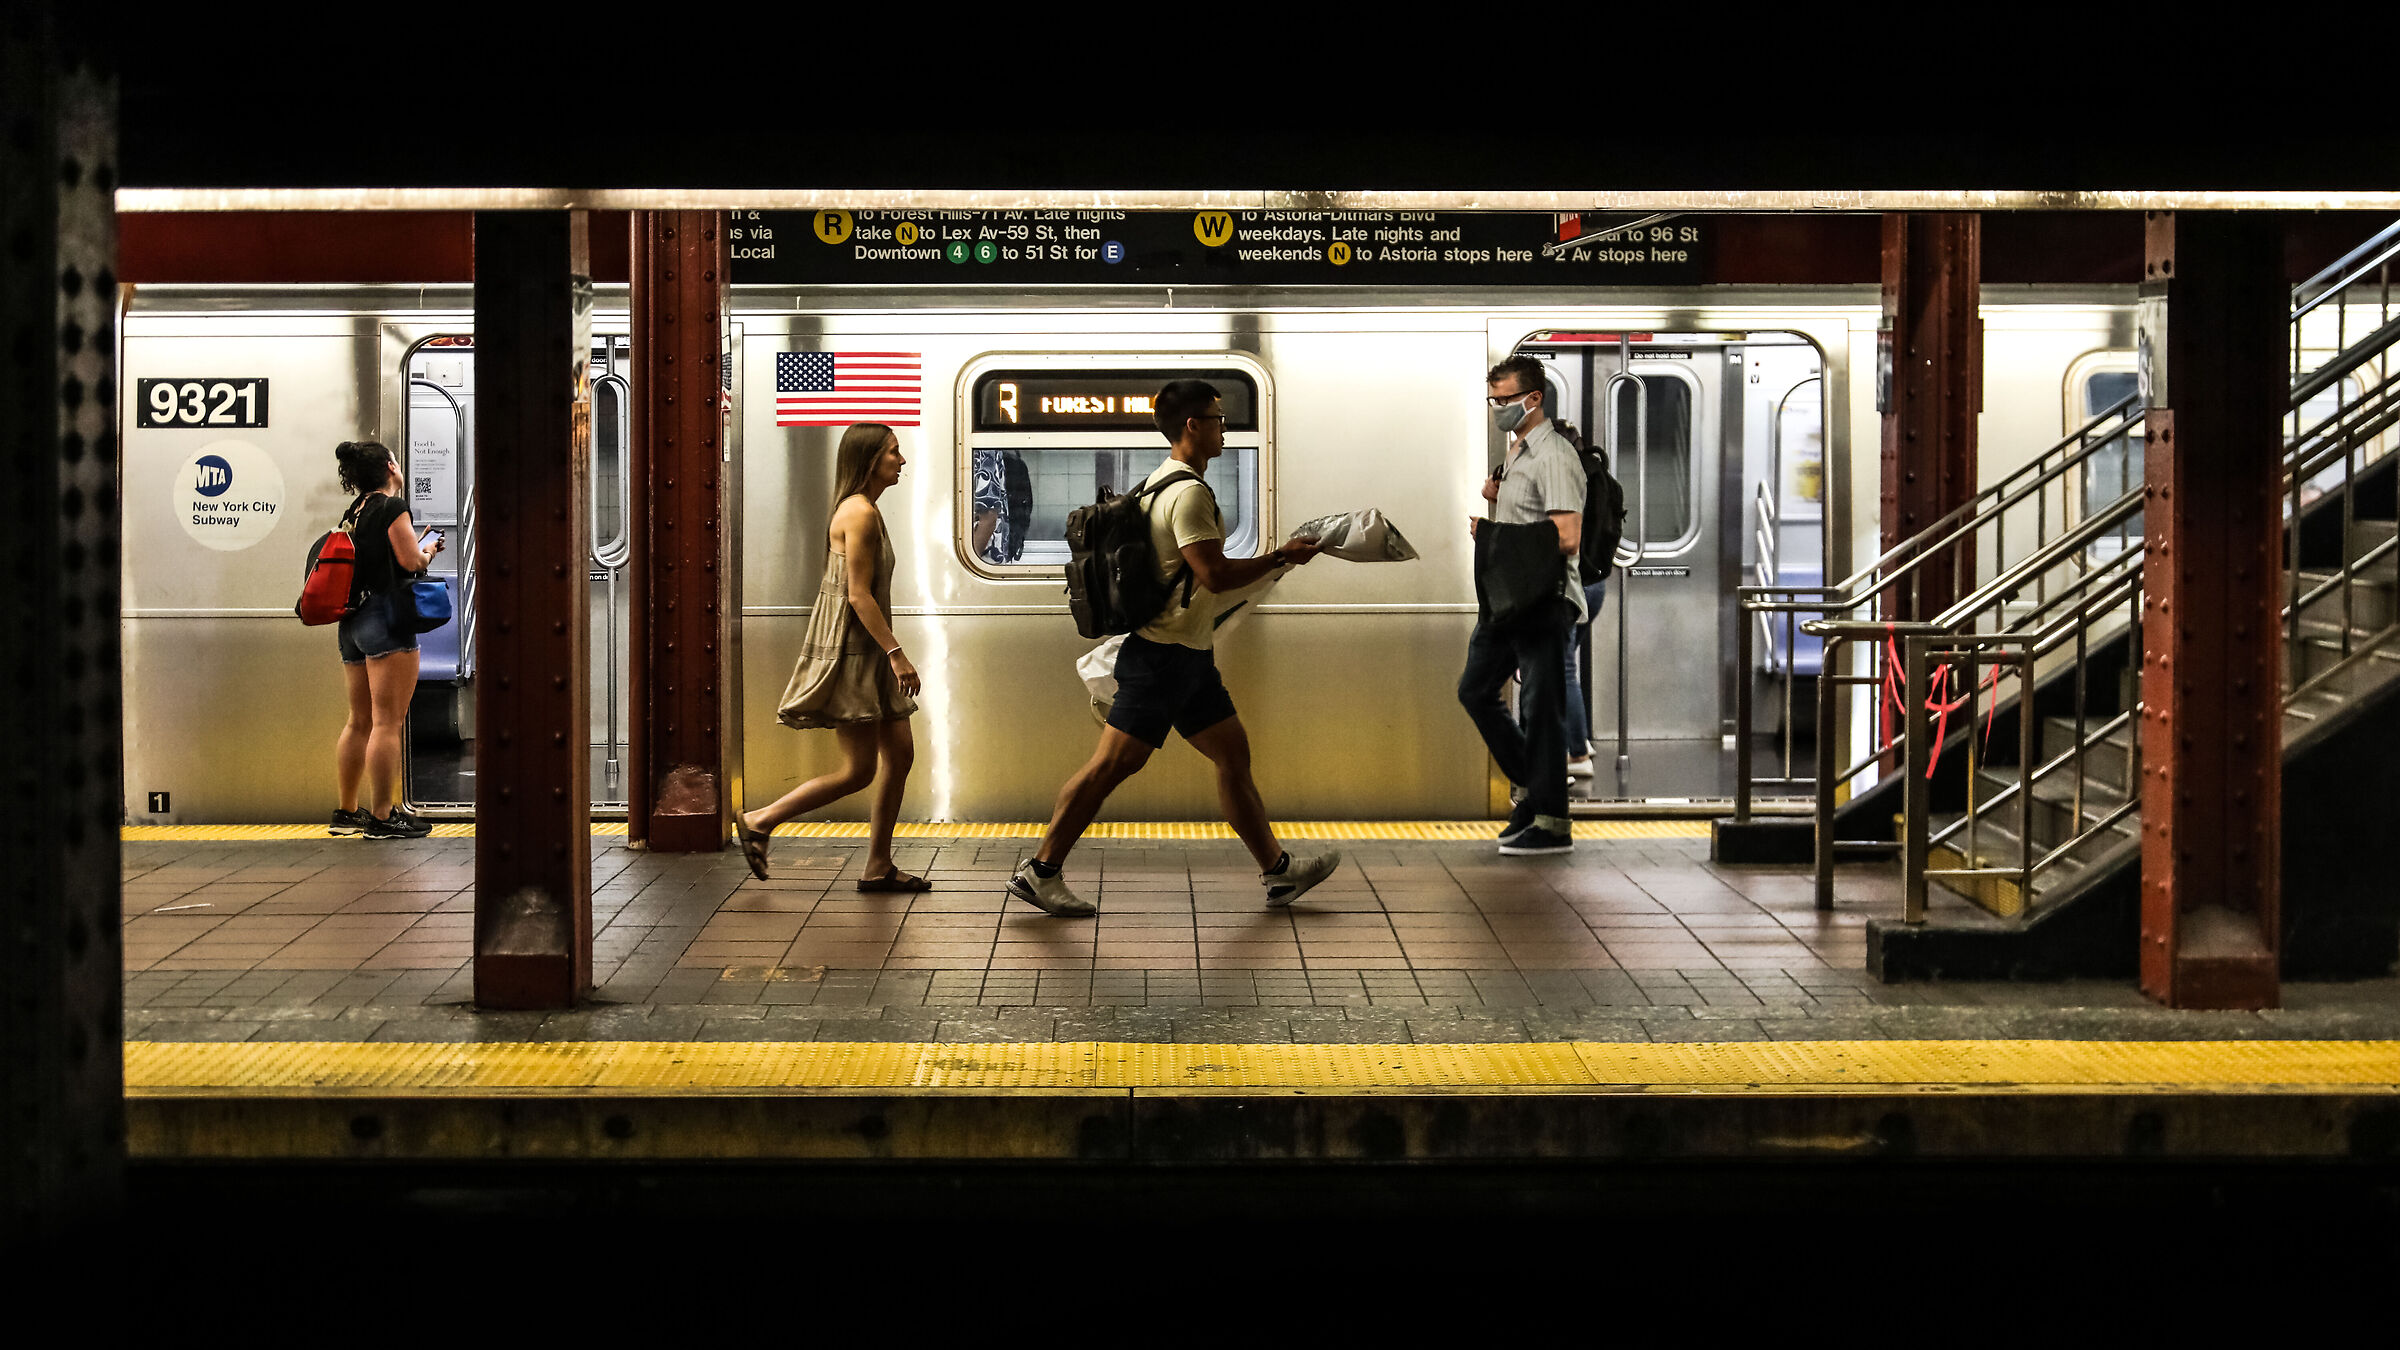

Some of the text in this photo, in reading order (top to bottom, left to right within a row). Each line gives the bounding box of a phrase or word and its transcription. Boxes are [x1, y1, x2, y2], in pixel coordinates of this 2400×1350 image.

[824, 213, 843, 236] R
[881, 210, 933, 220] Forest
[1004, 210, 1028, 220] Av.
[1035, 210, 1070, 220] Late
[1077, 210, 1125, 223] nights
[1401, 212, 1435, 222] Blvd
[750, 225, 773, 240] via
[855, 225, 1101, 242] take N to Lex Av-59 St, then
[1200, 215, 1227, 238] W
[1238, 226, 1461, 244] weekdays. Late nights and
[1627, 228, 1644, 242] to
[1651, 226, 1673, 242] 96
[1680, 226, 1699, 242] St
[731, 244, 775, 259] Local
[855, 245, 1118, 260] Downtown 4 6 to 51 St for E
[1238, 246, 1533, 264] weekends N to Astoria stops here
[1572, 247, 1592, 261] Av
[1599, 248, 1645, 264] stops
[1652, 246, 1688, 261] here
[150, 382, 256, 424] 9321
[1000, 383, 1018, 424] R
[1123, 396, 1157, 414] HIL
[194, 464, 227, 489] MTA
[192, 501, 276, 515] New York City
[192, 514, 240, 528] Subway
[154, 793, 163, 812] 1
